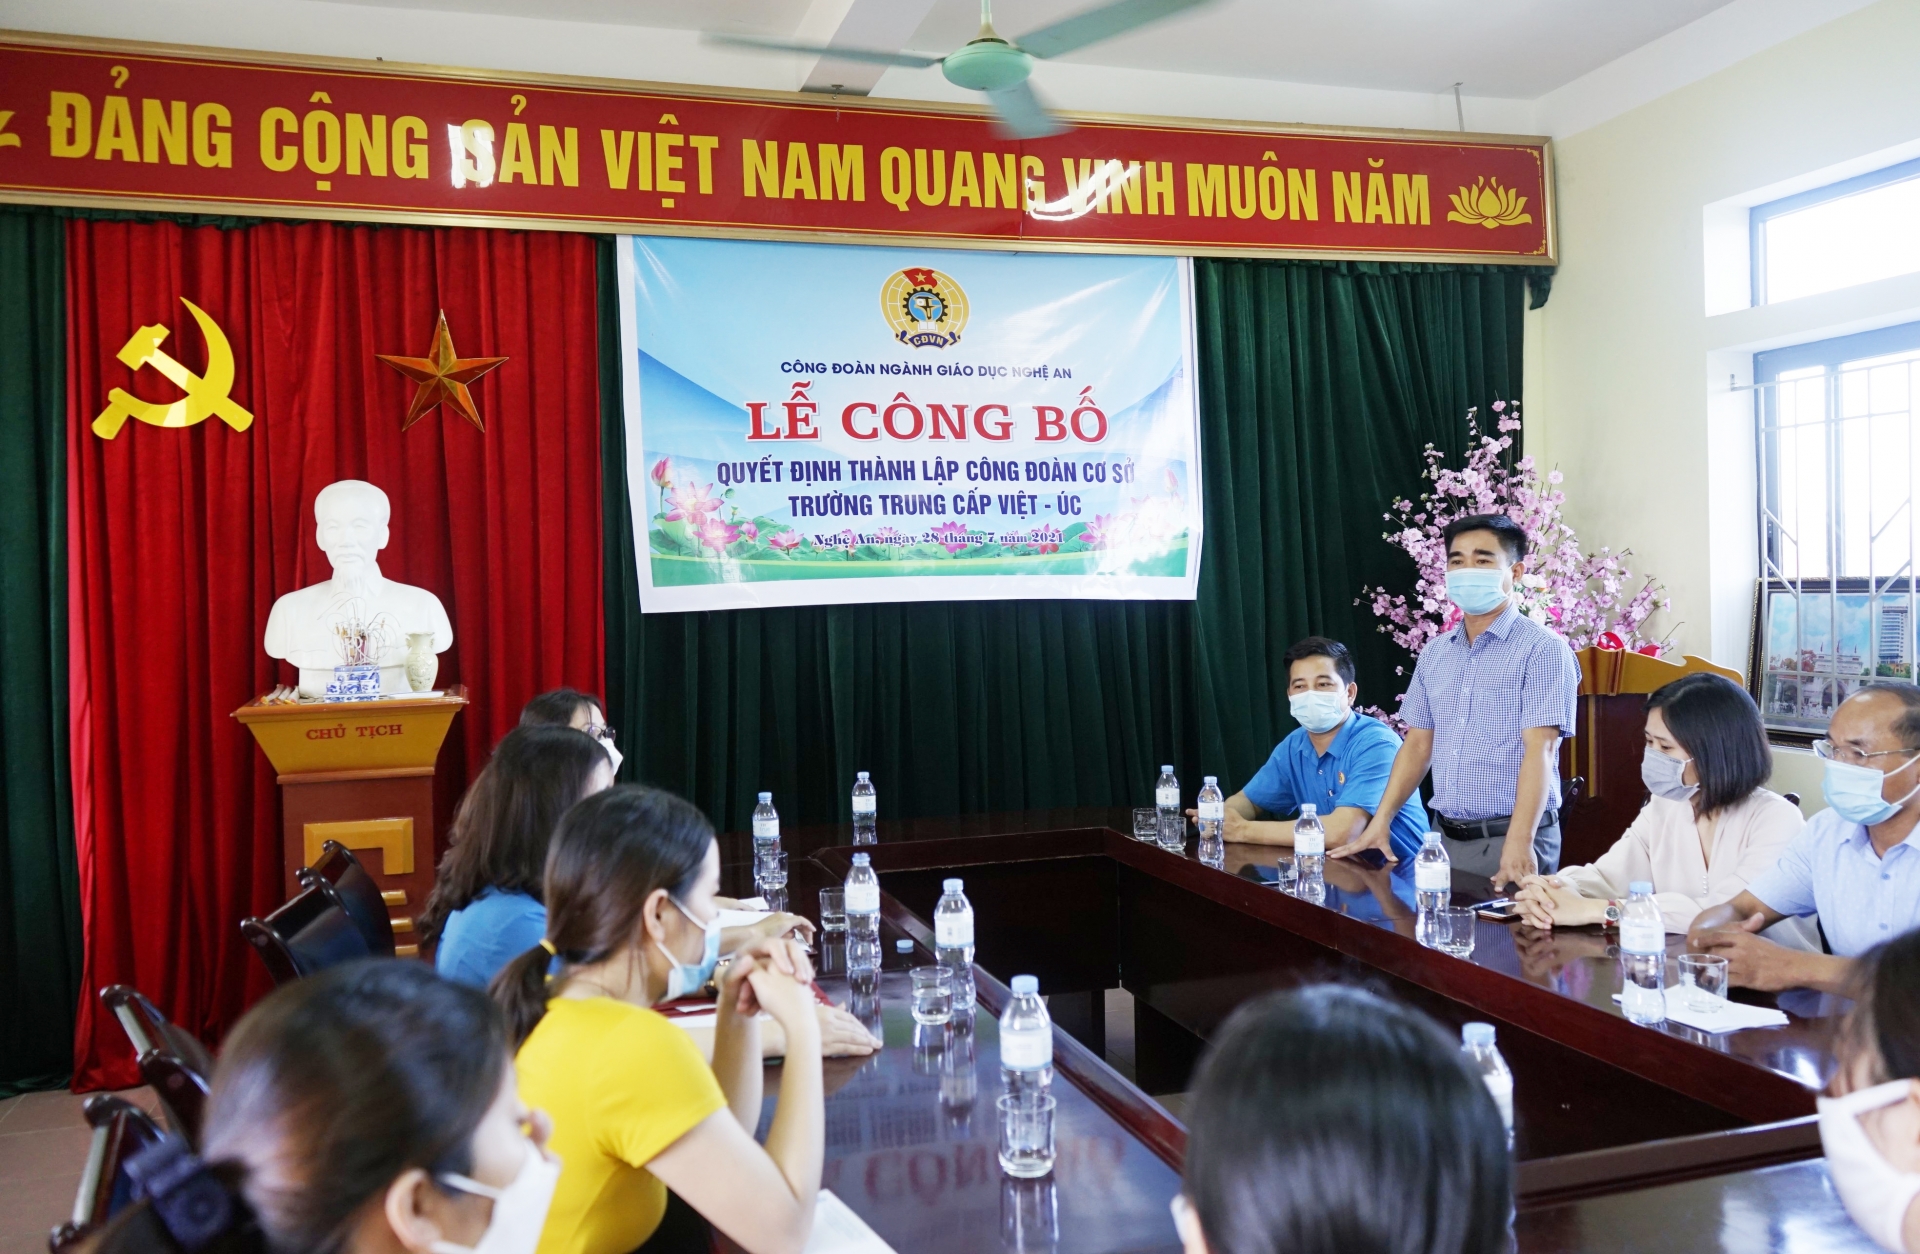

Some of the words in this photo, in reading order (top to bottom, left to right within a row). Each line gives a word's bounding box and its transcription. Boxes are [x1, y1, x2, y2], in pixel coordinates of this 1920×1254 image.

[47, 66, 232, 169] ĐẢNG
[260, 91, 429, 191] CỘNG
[459, 94, 580, 188] SẢN
[600, 113, 719, 208] VIỆT
[742, 138, 865, 202] NAM
[880, 145, 1046, 212] QUANG
[1065, 157, 1174, 216] VINH
[1186, 151, 1319, 221] MUÔN
[1334, 157, 1431, 226] NĂM
[913, 334, 944, 345] CĐVN
[780, 359, 827, 374] CÔNG
[832, 360, 875, 375] ĐOÀN
[880, 360, 933, 376] NGÀNH
[937, 361, 974, 377] GIÁO
[978, 366, 1007, 380] DỤC
[1012, 362, 1049, 381] NGHỆ
[1053, 368, 1072, 379] AN
[745, 380, 819, 442] LỄ
[841, 391, 1014, 441] CÔNG
[1032, 385, 1110, 443] BỐ
[717, 454, 784, 486] QUYẾT
[790, 460, 841, 486] ĐỊNH
[847, 455, 916, 482] THÀNH
[922, 456, 959, 486] LẬP
[966, 456, 1020, 482] CÔNG
[1025, 456, 1077, 482] ĐOÀN
[1082, 460, 1107, 483] CƠ
[1112, 456, 1135, 484] SỞ
[788, 489, 873, 518] TRƯỜNG
[879, 493, 946, 516] TRUNG
[952, 486, 992, 516] CẤP
[997, 489, 1038, 520] VIỆT
[1057, 490, 1082, 516] ÚC
[813, 533, 850, 549] Nghệ
[884, 533, 918, 548] ngày
[922, 532, 940, 543] 28
[944, 532, 983, 546] tháng
[987, 532, 995, 543] 7
[1031, 533, 1064, 544] 2021
[306, 723, 347, 740] CHỦ
[356, 724, 403, 739] TỊCH
